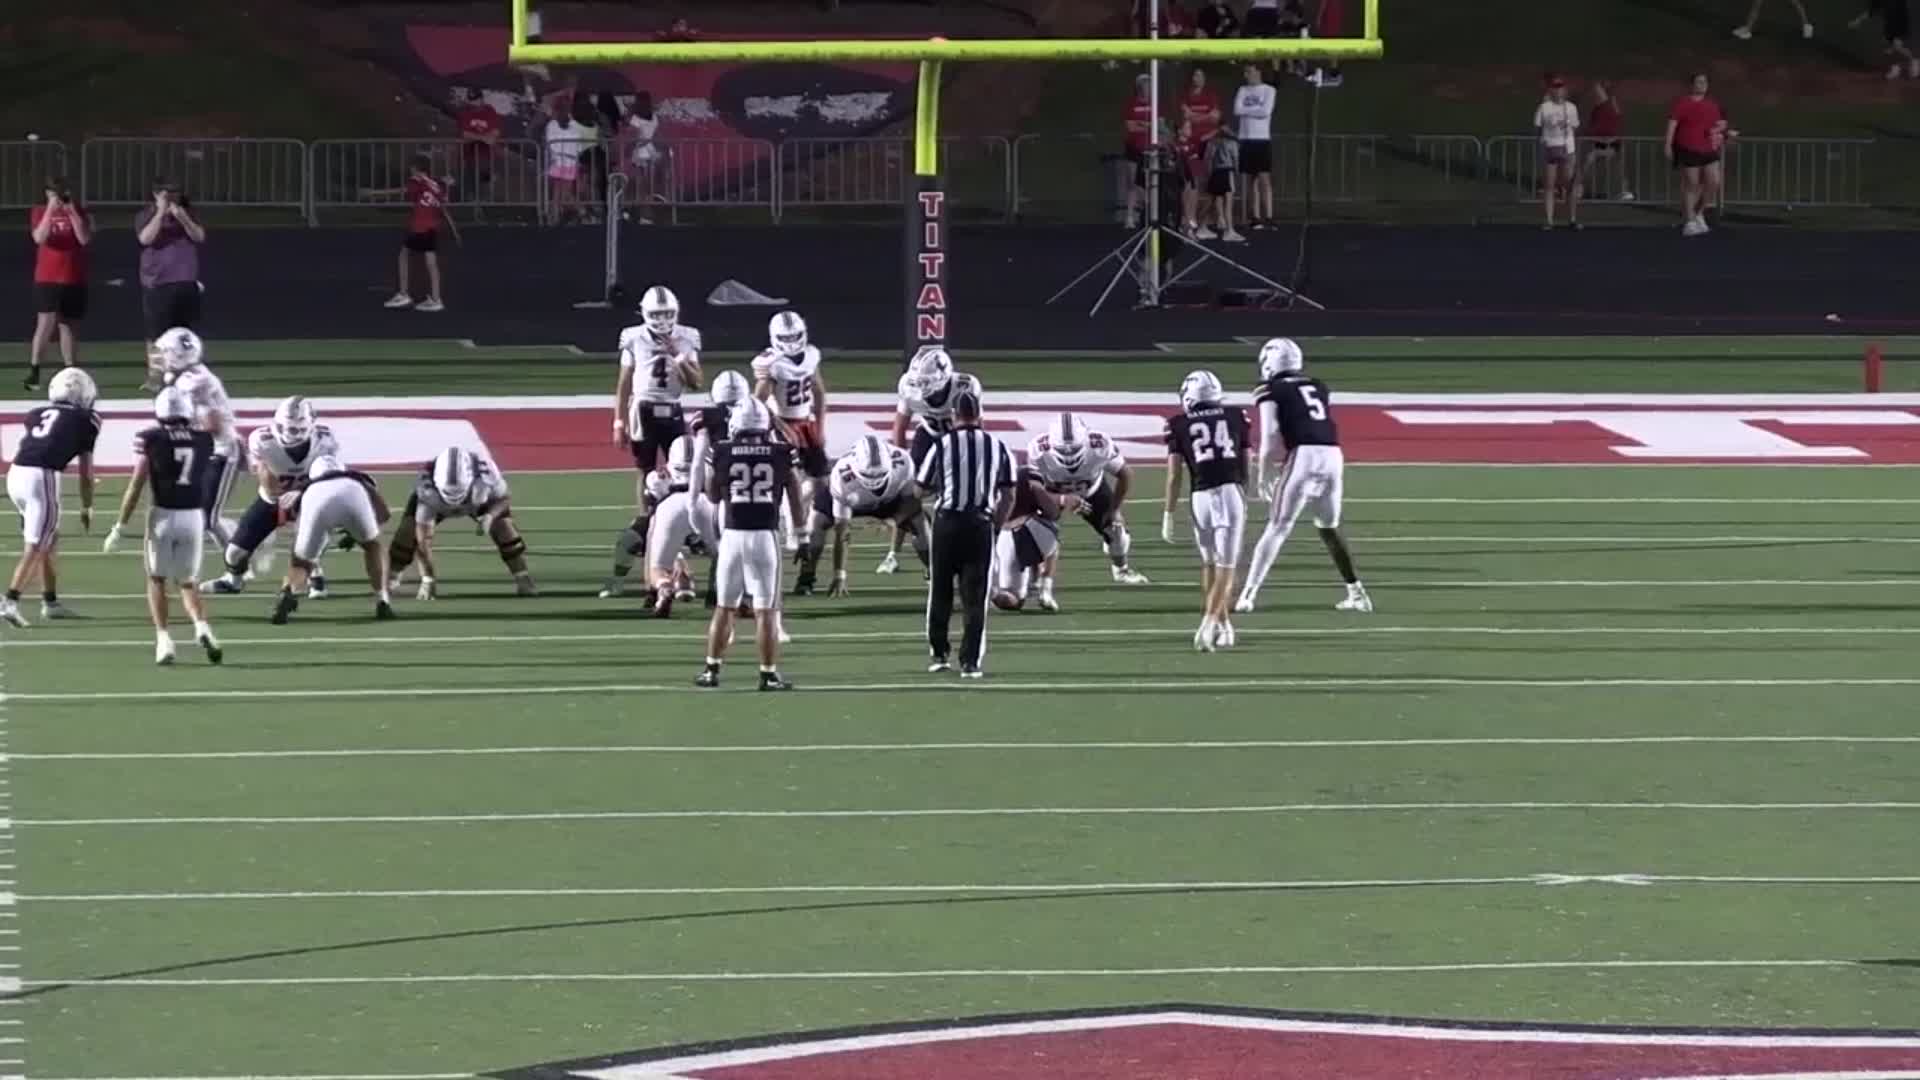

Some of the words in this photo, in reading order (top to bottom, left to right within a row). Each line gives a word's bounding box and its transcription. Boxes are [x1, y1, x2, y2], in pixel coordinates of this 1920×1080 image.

[651, 354, 668, 389] 4
[1298, 385, 1326, 421] 5
[32, 408, 60, 439] 3
[1189, 419, 1236, 464] 24
[173, 446, 196, 486] 7
[729, 462, 775, 504] 22
